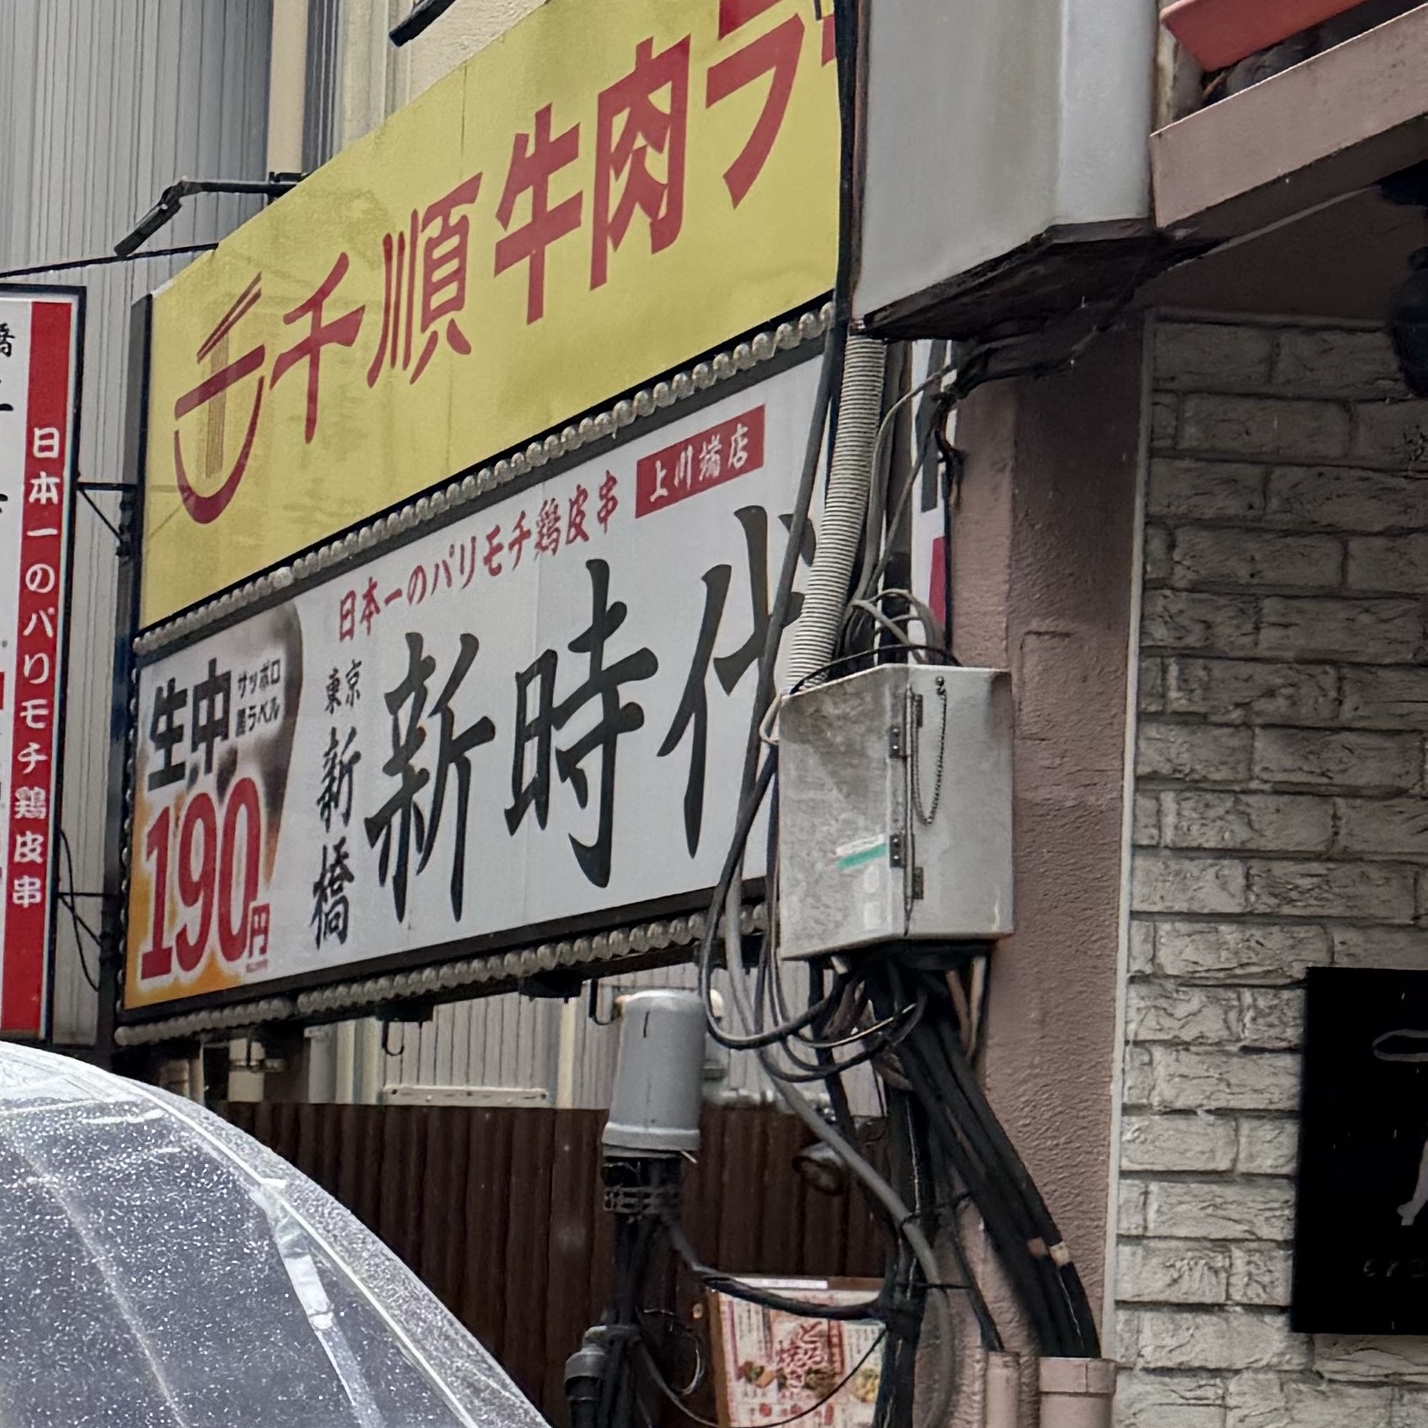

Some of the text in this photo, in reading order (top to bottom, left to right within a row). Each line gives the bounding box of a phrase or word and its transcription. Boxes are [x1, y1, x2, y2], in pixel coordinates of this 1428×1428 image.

[270, 0, 837, 444] 千順牛肉ラ
[649, 424, 748, 501] 上川端店
[147, 658, 232, 792] 生中
[324, 658, 362, 714] 東京
[364, 505, 816, 921] 新時代
[312, 726, 362, 949] 新橋
